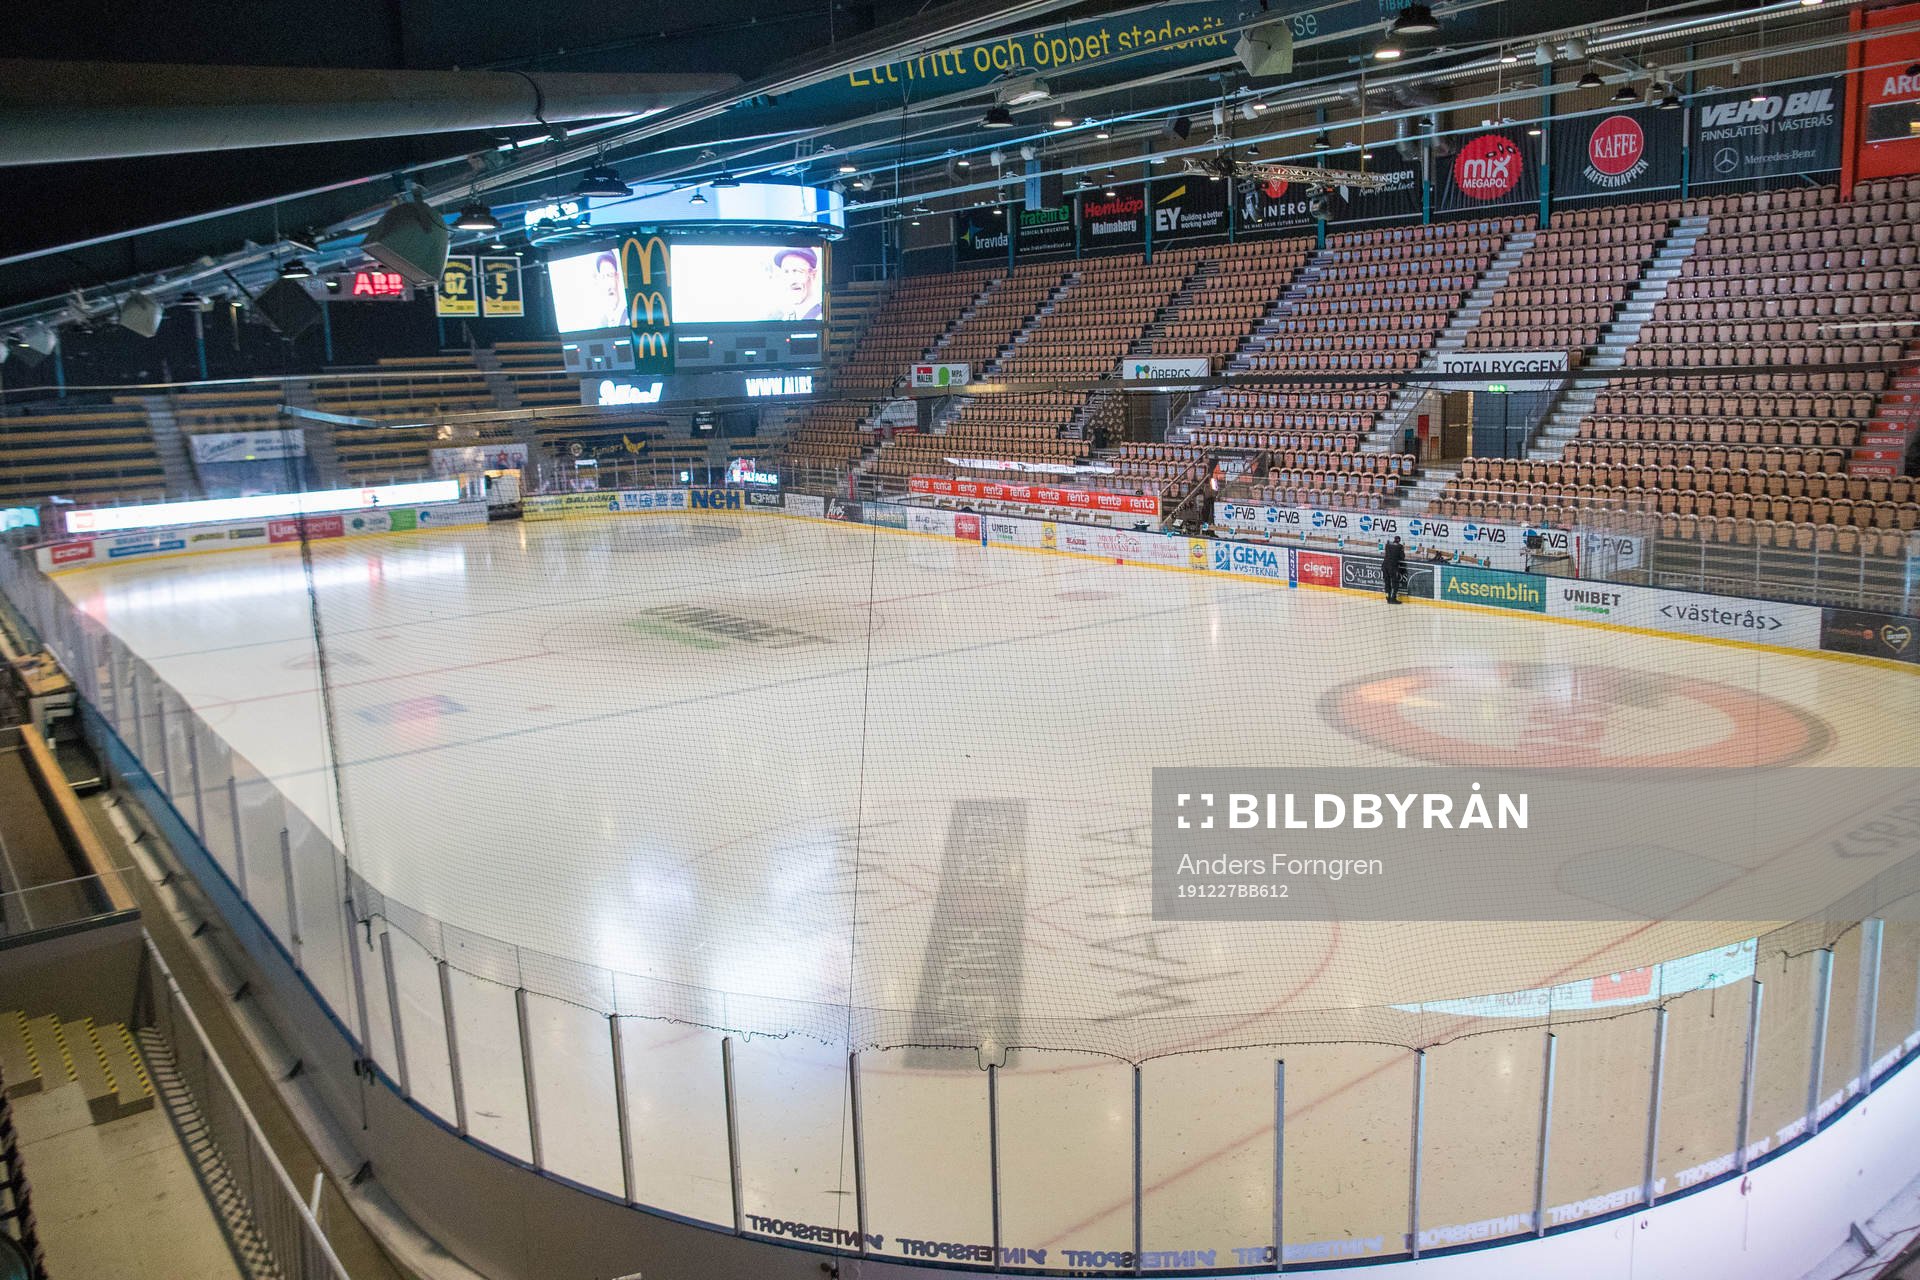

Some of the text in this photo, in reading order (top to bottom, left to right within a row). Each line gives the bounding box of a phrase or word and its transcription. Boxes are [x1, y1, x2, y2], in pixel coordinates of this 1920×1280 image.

[973, 37, 1025, 71] och
[1034, 27, 1110, 67] öppet
[1701, 88, 1834, 128] VEHO BIL
[1701, 114, 1833, 142] FINNSLÄTTEN VÄSTERÅS
[1594, 132, 1637, 159] KAFFE
[1744, 149, 1816, 165] Mercedes-Benz
[1464, 154, 1511, 178] mix
[1583, 159, 1650, 188] KAFFEKNAPPEN
[1463, 177, 1508, 189] MEGAPOL
[1084, 196, 1144, 218] Hemköp
[1156, 206, 1181, 232] EY
[975, 233, 1008, 250] bravida
[353, 271, 404, 296] ABB
[495, 272, 509, 295] 5
[911, 479, 929, 489] renta
[933, 481, 952, 491] renta
[958, 483, 977, 494] renta
[984, 485, 1003, 496] renta
[1010, 487, 1030, 498] renta
[1038, 489, 1059, 501] renta
[1067, 491, 1090, 503] renta
[1098, 494, 1122, 507] renta
[1130, 497, 1155, 509] renta
[1235, 506, 1256, 521] FVB
[1277, 510, 1300, 524] FVB
[1324, 514, 1348, 528] FVB
[1372, 518, 1397, 533] FVB
[1422, 522, 1450, 538] FVB
[1478, 527, 1506, 543] FVB
[1233, 545, 1278, 569] GEMA
[1303, 561, 1333, 574] clean
[1345, 564, 1408, 583] SALBOS
[1447, 576, 1540, 603] Assemblin
[1564, 588, 1622, 606] UNIBET
